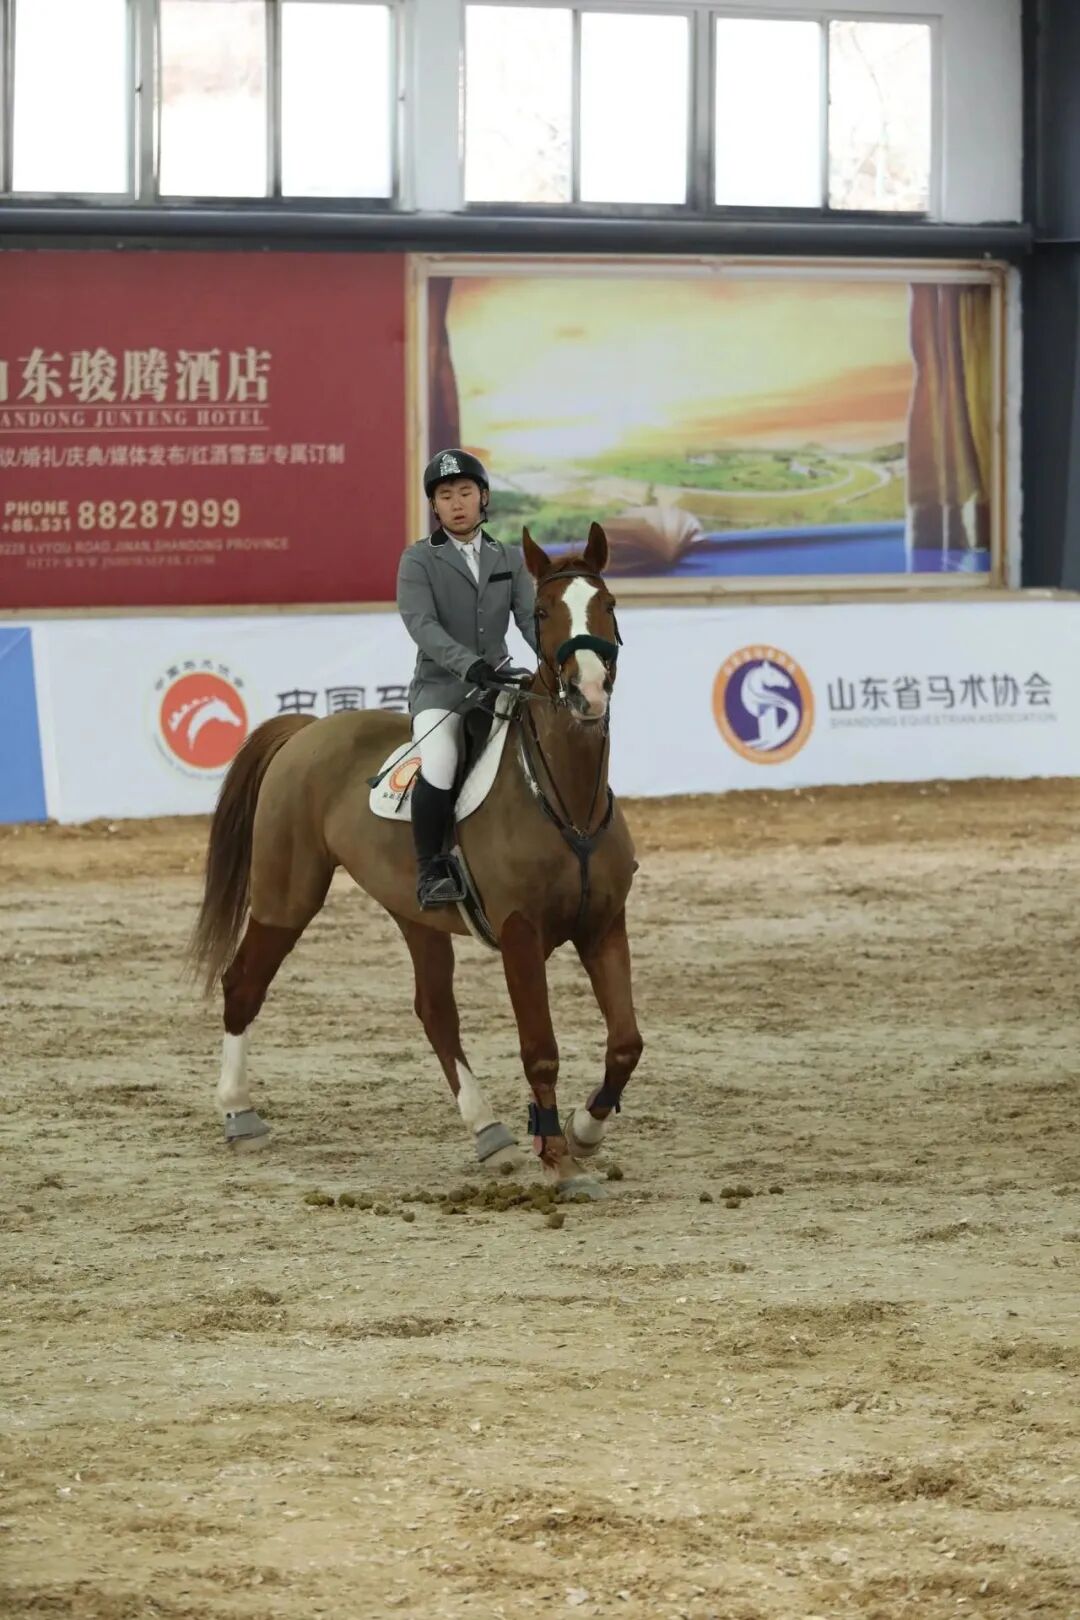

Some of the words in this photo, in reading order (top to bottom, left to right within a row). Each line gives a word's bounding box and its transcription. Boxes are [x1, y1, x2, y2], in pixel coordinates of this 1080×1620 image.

[95, 410, 187, 426] JUNTENG
[197, 409, 264, 426] HOTEL
[5, 501, 69, 515] PHONE
[78, 498, 240, 529] 88287999
[828, 673, 1051, 711] 山东省马术协会
